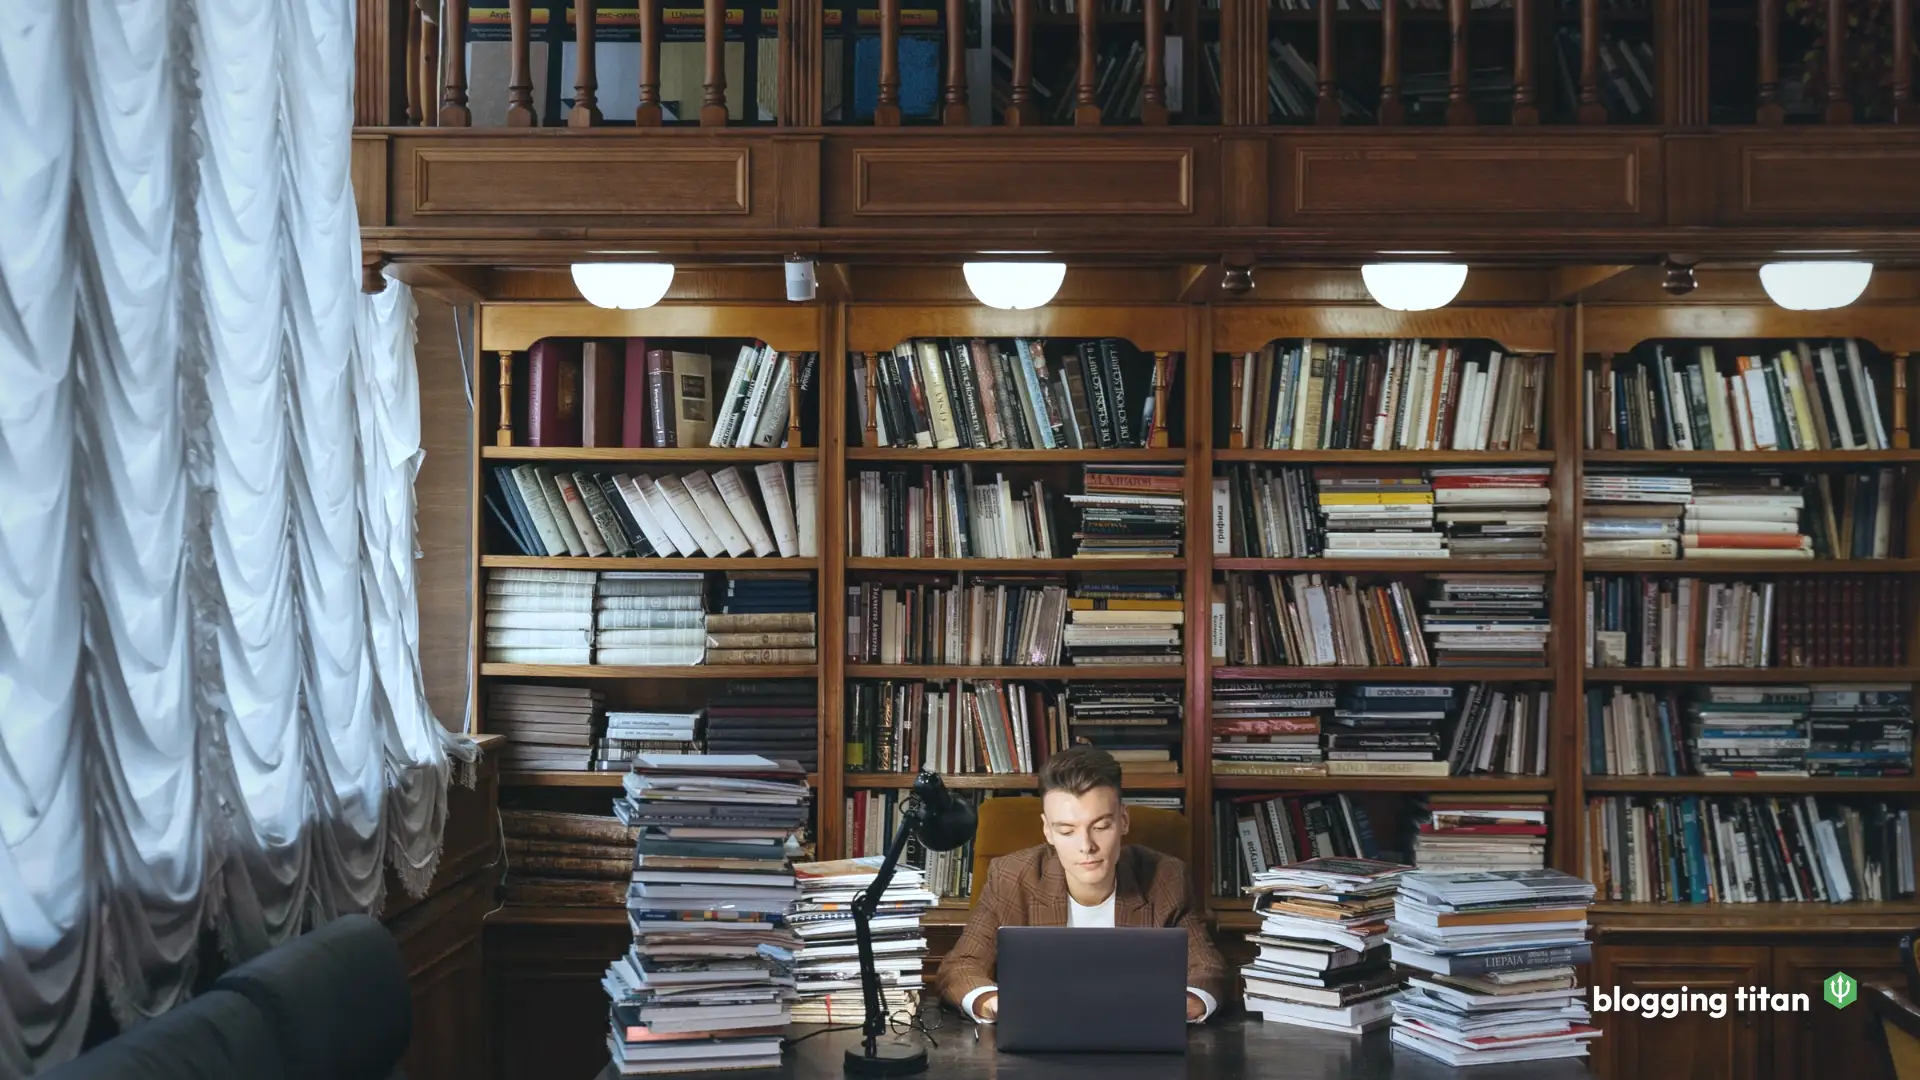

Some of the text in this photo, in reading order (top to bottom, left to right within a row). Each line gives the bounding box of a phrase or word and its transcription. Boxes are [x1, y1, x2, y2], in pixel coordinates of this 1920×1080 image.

[1216, 505, 1226, 544] графика
[1306, 690, 1335, 699] PARIS
[1376, 688, 1426, 697] architecture
